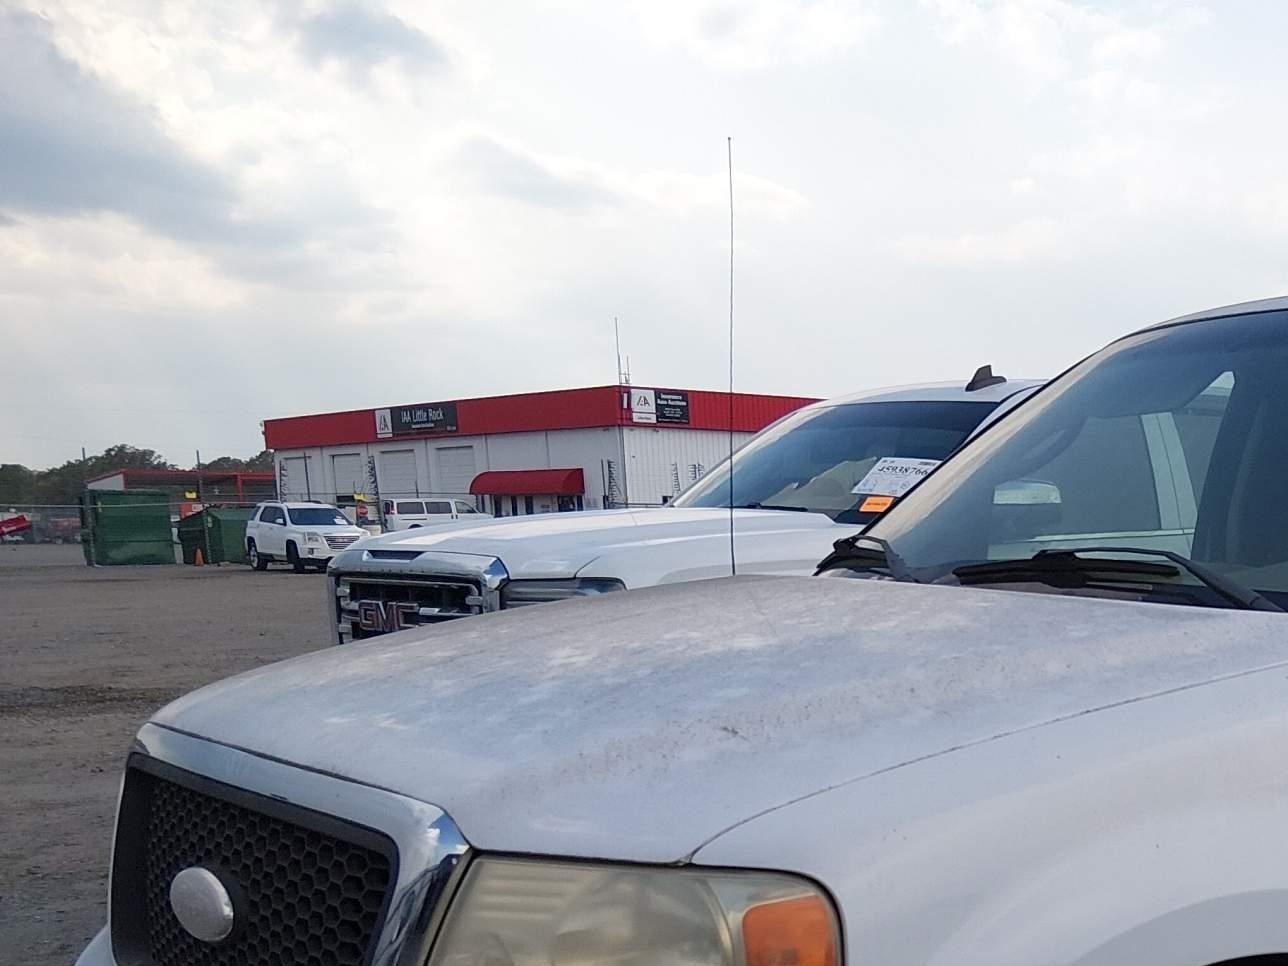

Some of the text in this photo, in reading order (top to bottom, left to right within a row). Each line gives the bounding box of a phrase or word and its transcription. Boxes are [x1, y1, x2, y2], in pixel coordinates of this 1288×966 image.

[412, 409, 428, 422] Little
[428, 408, 444, 421] Rock
[358, 601, 419, 631] GMC
